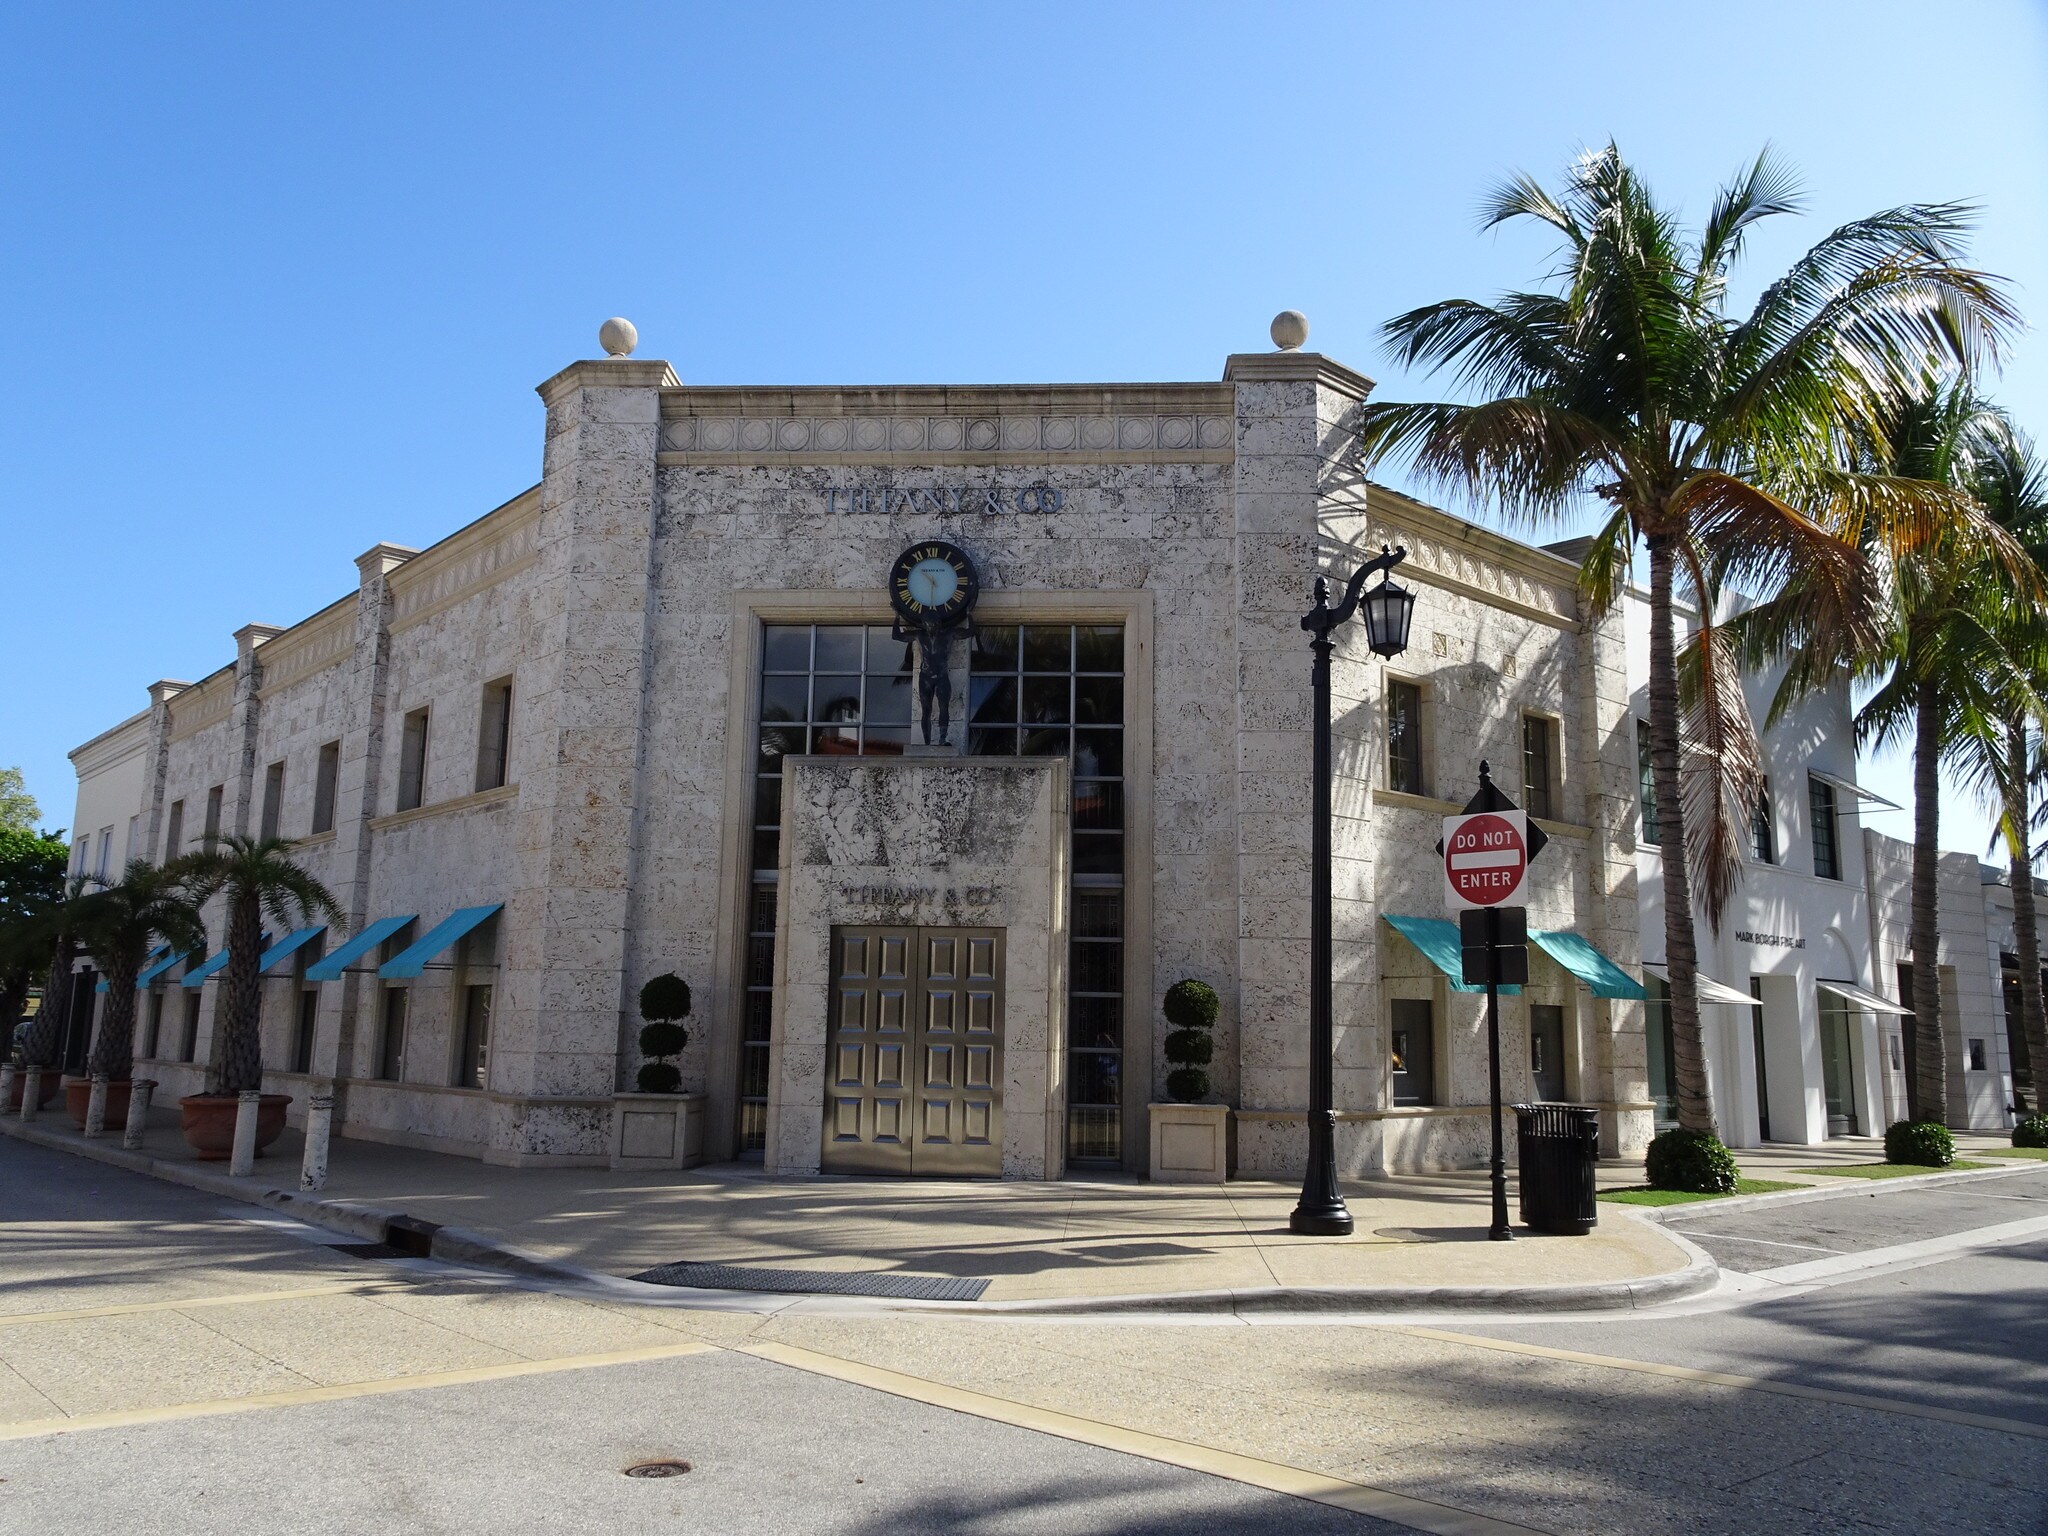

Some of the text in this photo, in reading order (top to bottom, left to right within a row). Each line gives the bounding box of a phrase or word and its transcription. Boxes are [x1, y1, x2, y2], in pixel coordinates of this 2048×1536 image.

[819, 487, 968, 514] TIFFANY
[985, 490, 1004, 515] &
[1457, 830, 1513, 849] DO NOT
[1460, 871, 1512, 888] ENTER
[842, 885, 937, 905] TIFFANY
[945, 887, 959, 904] &
[1735, 931, 1754, 944] MARK
[1794, 938, 1806, 949] ART
